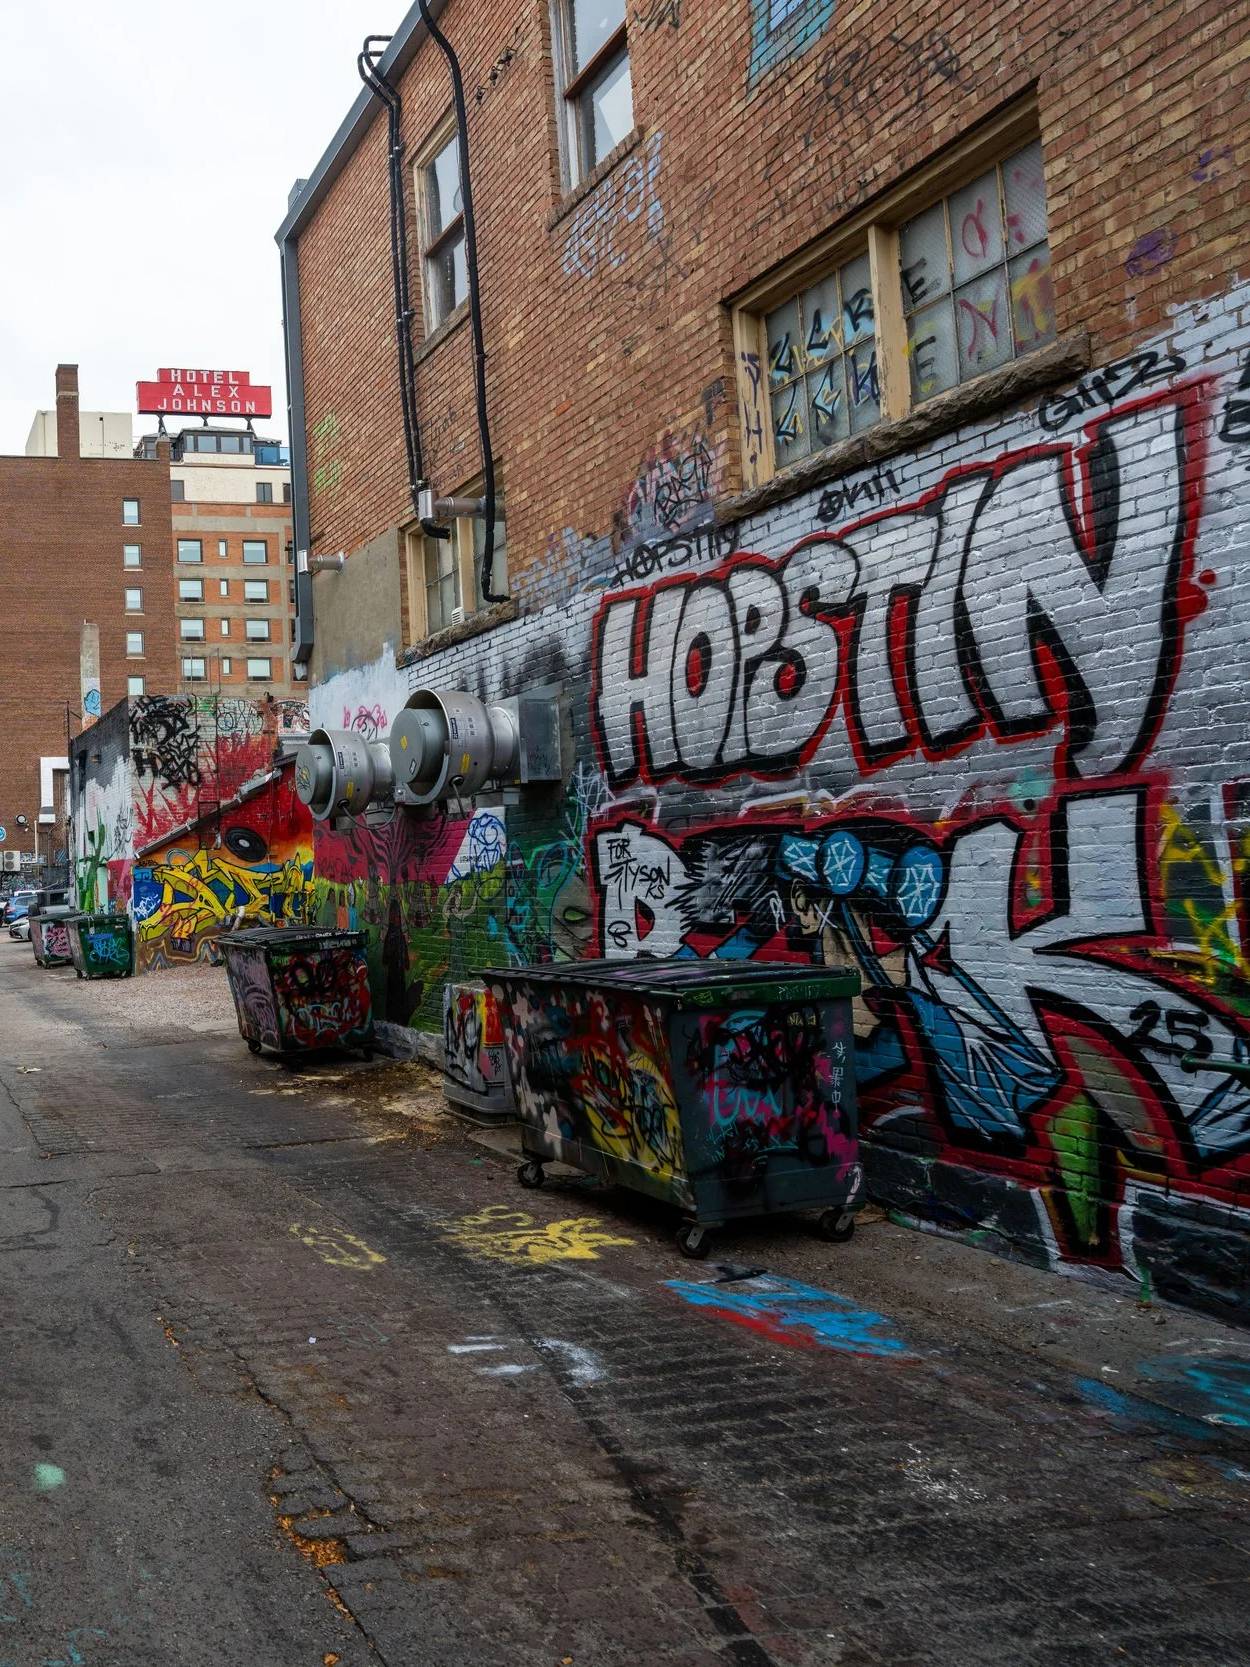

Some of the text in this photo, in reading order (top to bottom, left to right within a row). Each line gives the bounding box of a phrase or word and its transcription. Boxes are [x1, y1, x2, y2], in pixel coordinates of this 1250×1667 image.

[170, 369, 239, 384] HOTEL
[173, 383, 239, 398] ALEX
[157, 397, 256, 413] JOHNSON
[605, 838, 632, 863] FOR
[609, 855, 670, 893] TYSON
